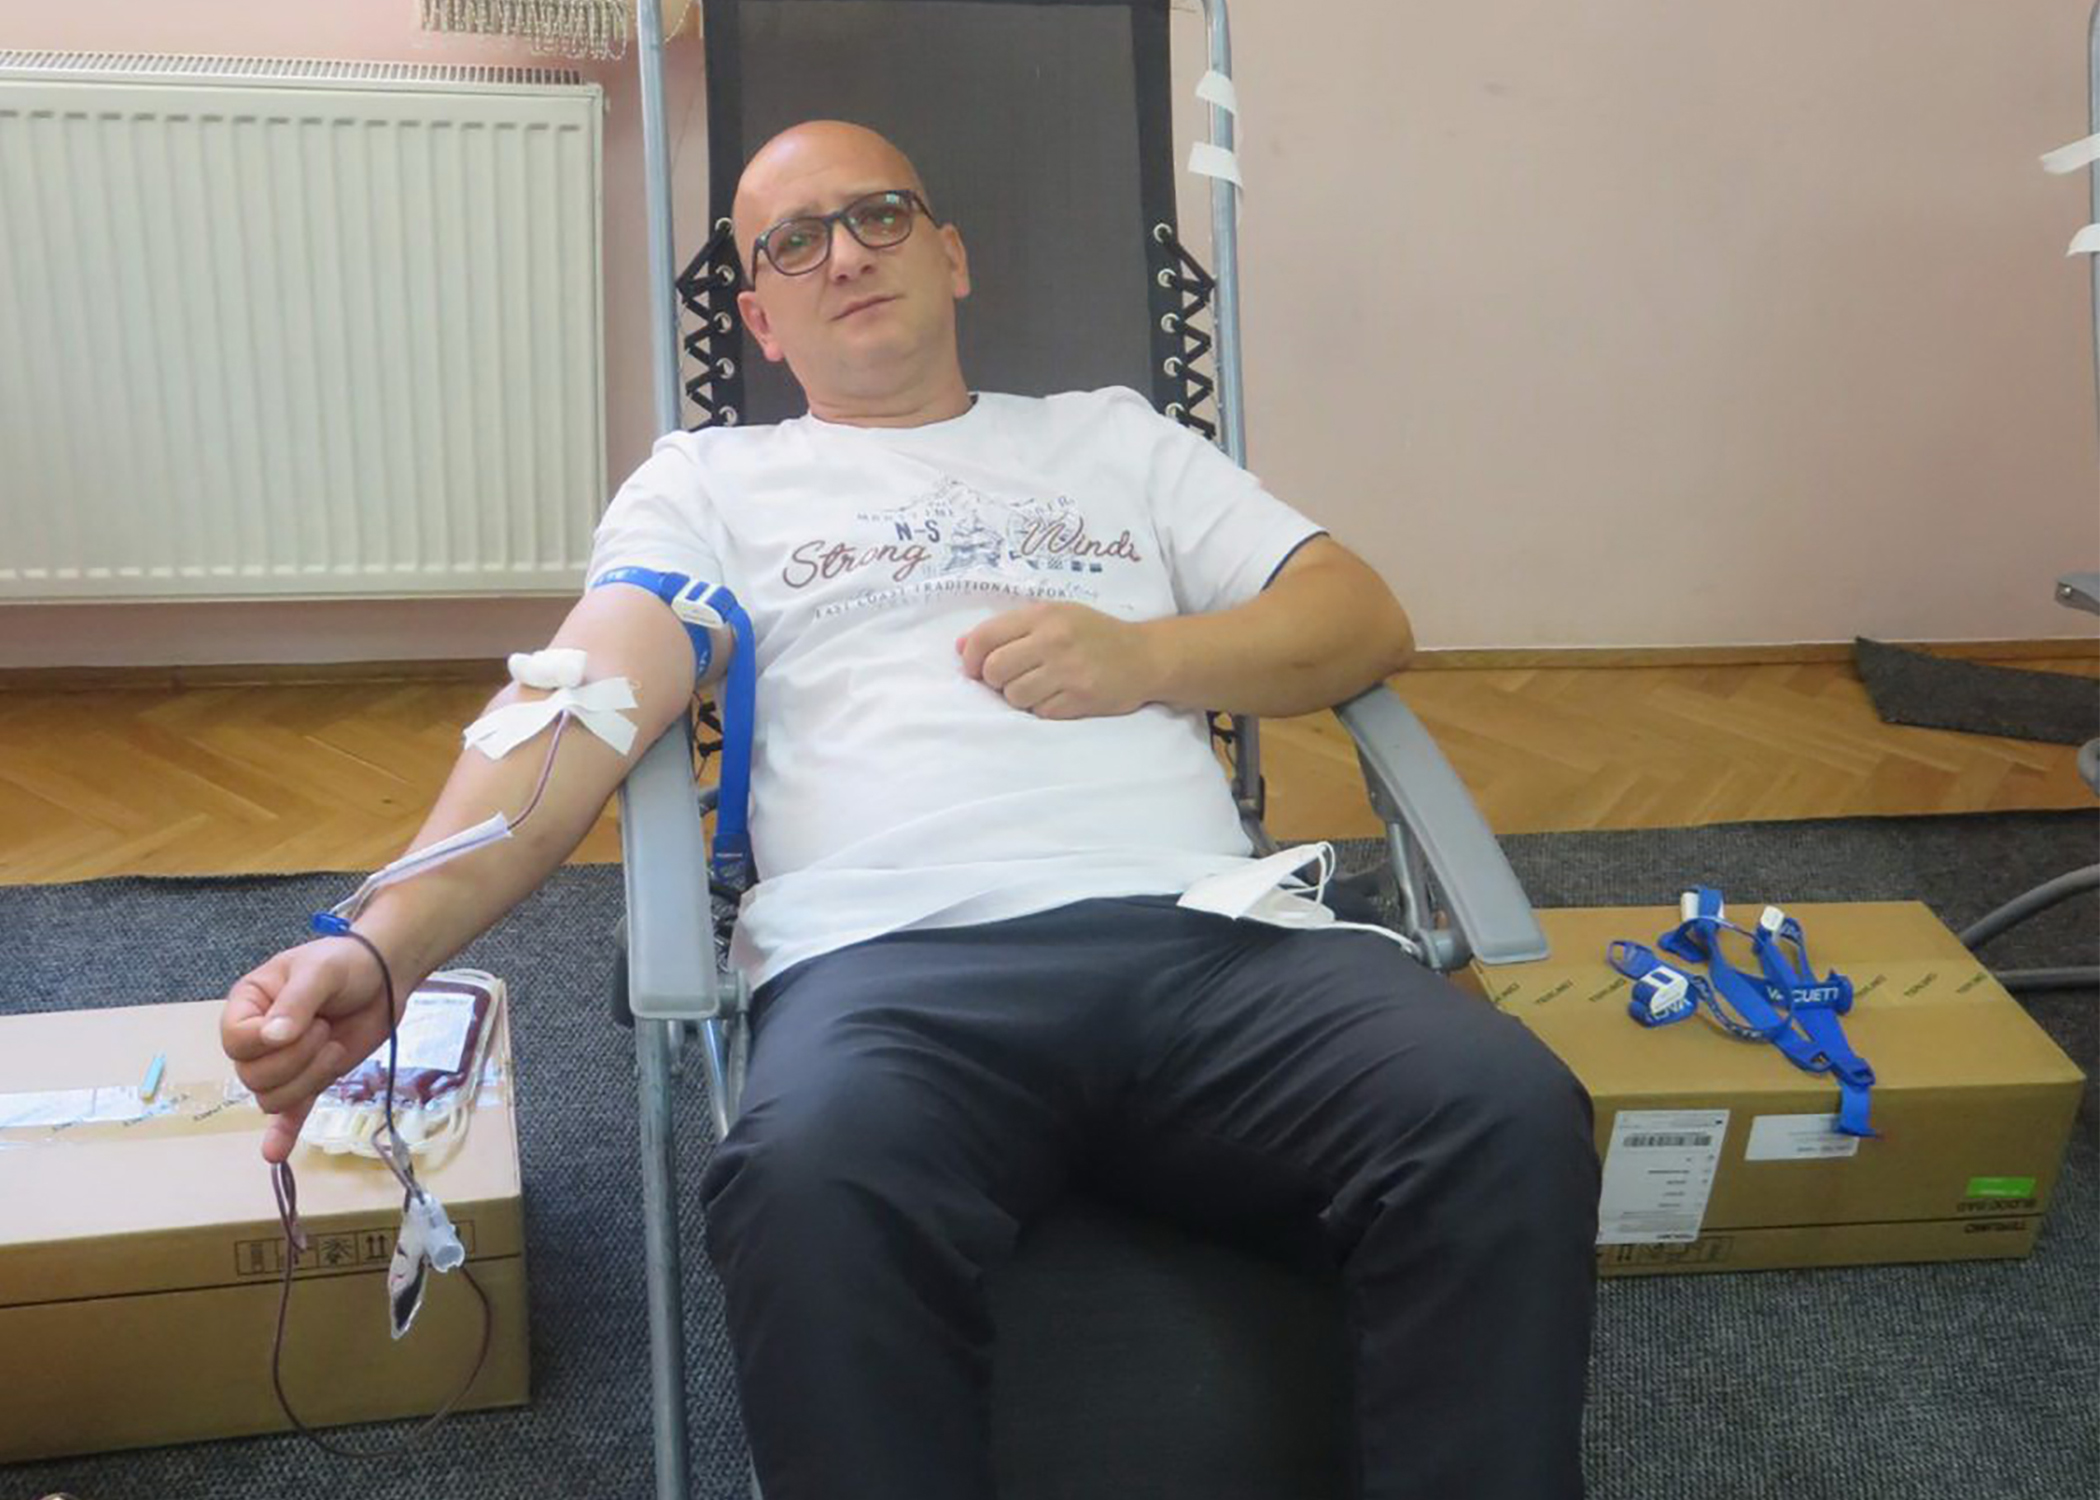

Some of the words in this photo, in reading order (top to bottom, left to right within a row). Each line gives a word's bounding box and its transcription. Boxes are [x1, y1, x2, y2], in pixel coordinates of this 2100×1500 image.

[895, 519, 941, 543] N-S
[783, 539, 931, 585] Strong
[915, 578, 1020, 597] TRADITIONAL
